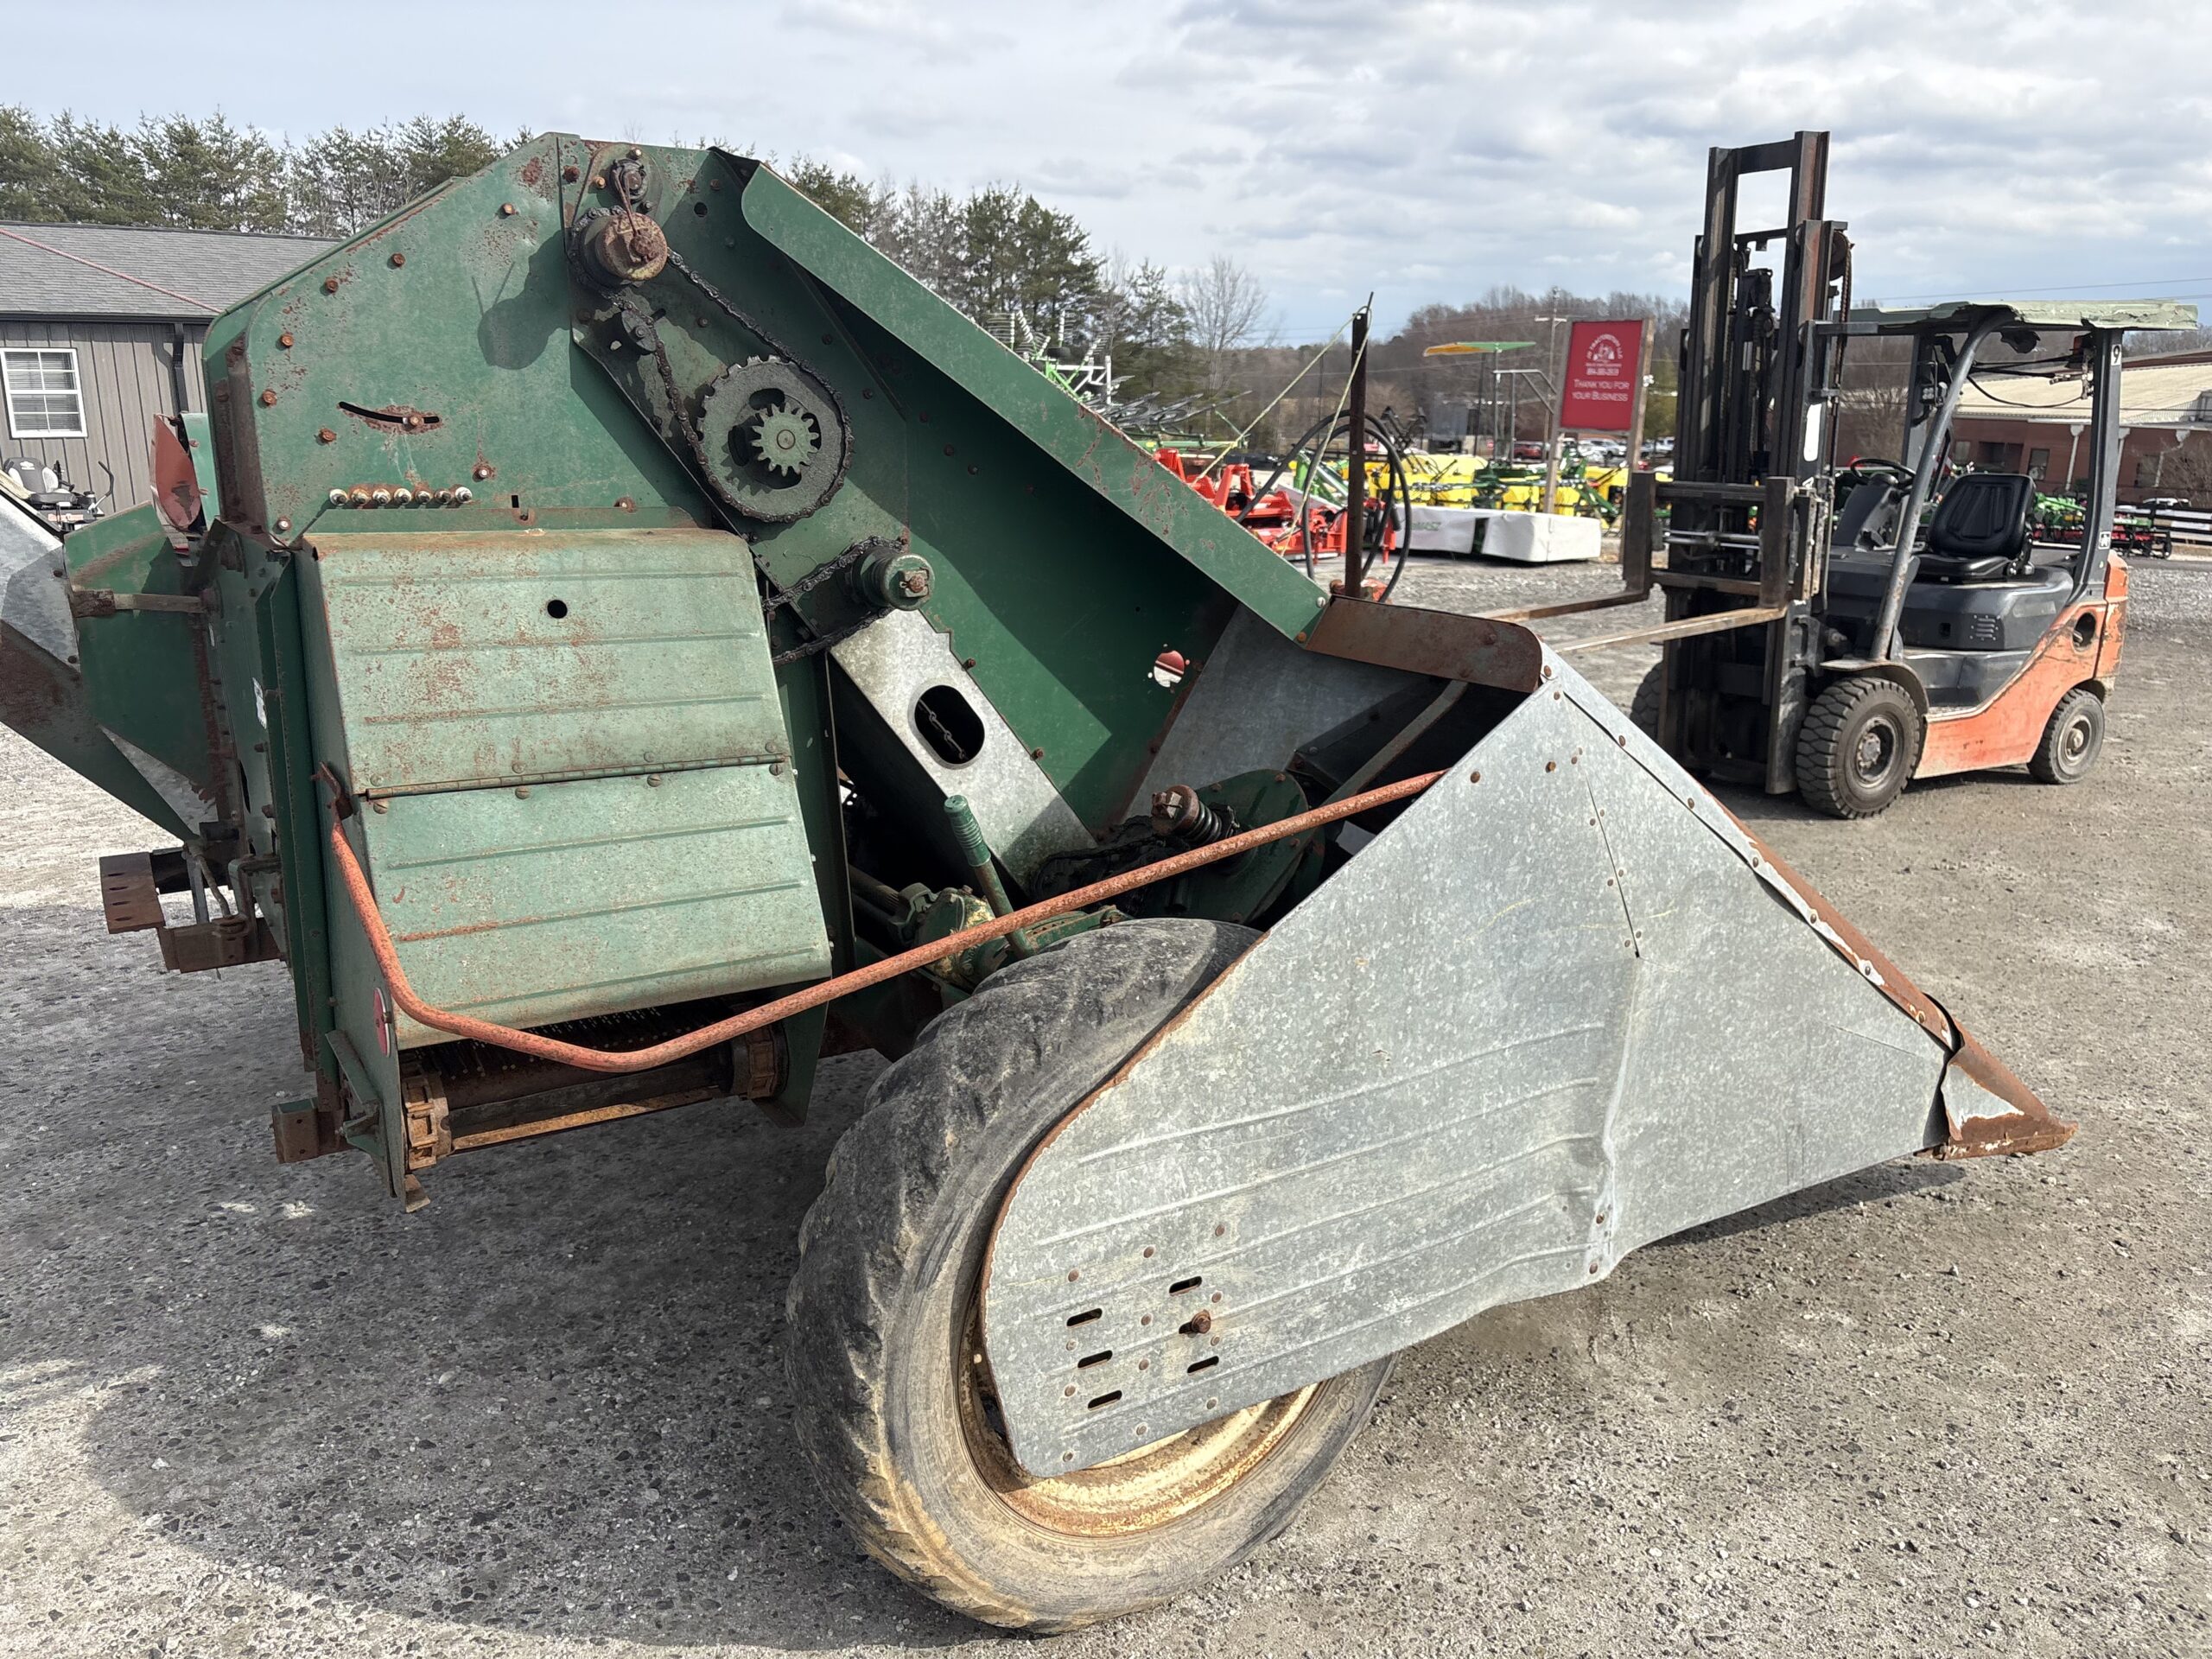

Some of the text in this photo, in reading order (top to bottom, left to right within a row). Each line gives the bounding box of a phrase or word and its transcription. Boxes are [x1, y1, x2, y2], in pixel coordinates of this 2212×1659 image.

[2113, 345, 2120, 364] 9
[1573, 379, 1630, 390] THANK YOU FOR
[1572, 391, 1629, 402] YOUR BUSINESS
